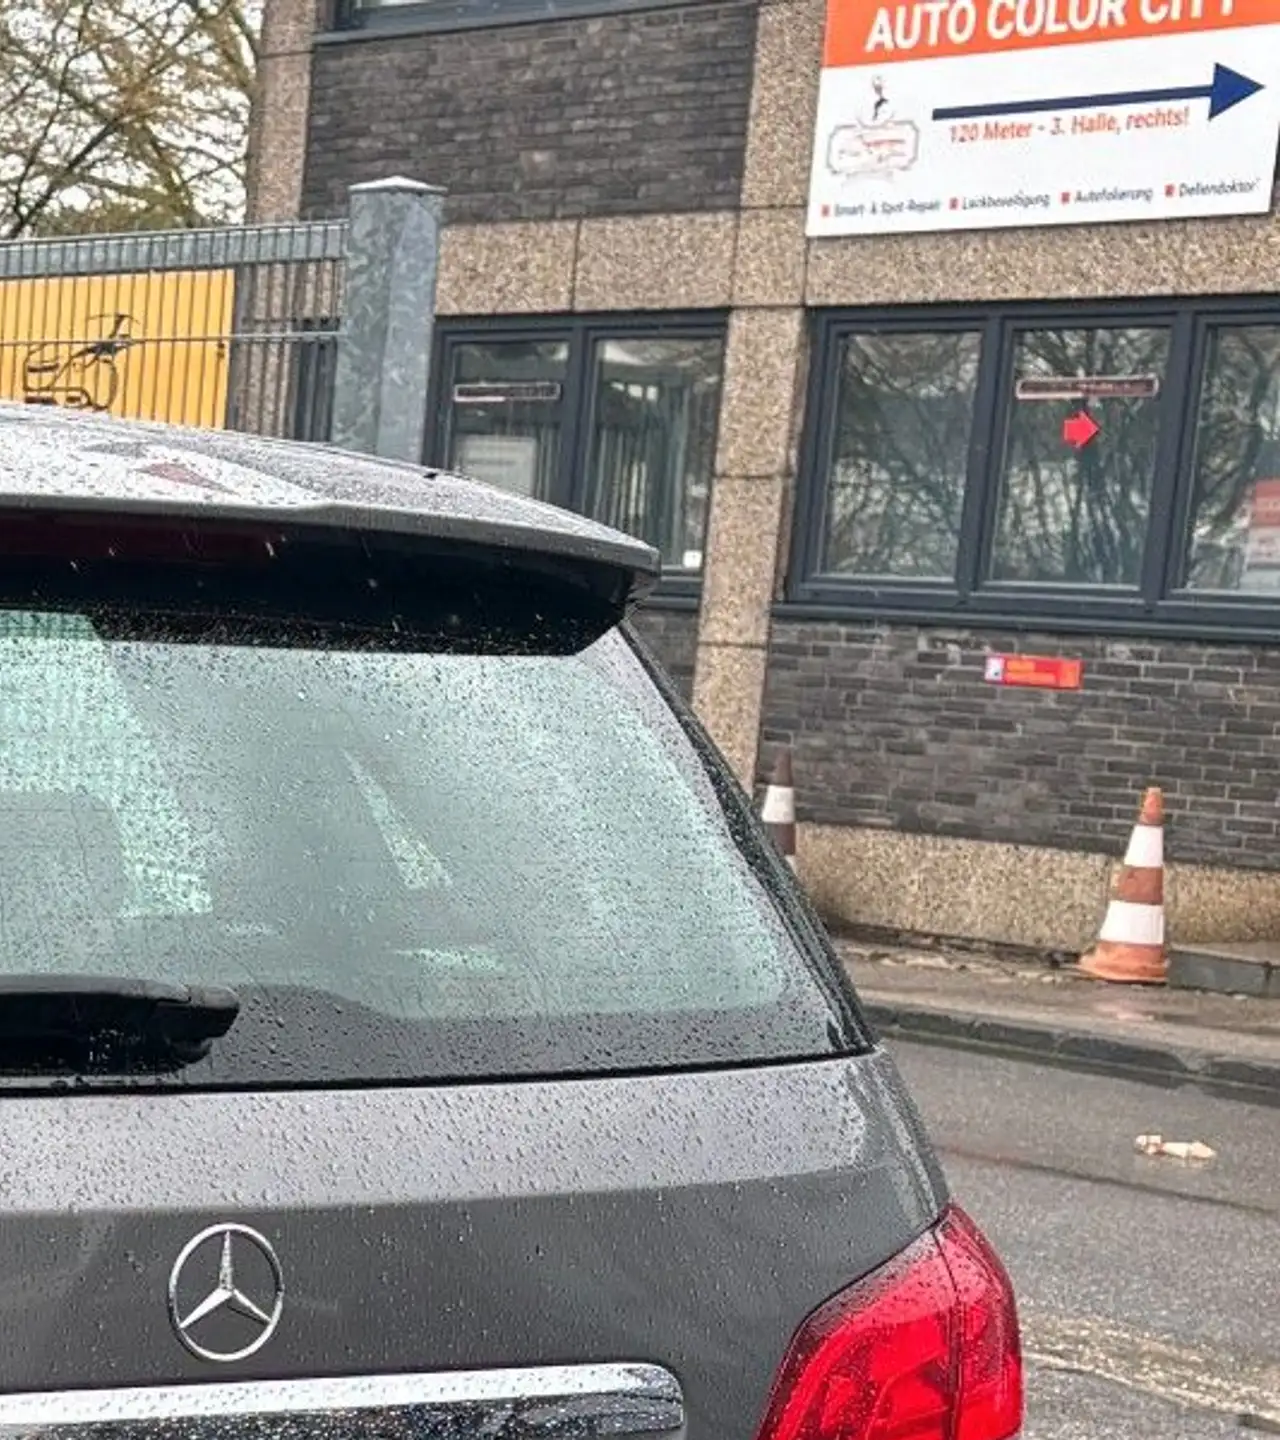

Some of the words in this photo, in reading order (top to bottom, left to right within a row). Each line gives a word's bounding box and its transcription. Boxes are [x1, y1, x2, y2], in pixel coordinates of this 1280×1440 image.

[865, 1, 977, 52] AUTO
[986, 0, 1127, 40] COLOR
[949, 123, 979, 143] 120
[982, 121, 1033, 141] Meter
[1049, 117, 1065, 136] 3.
[1071, 113, 1122, 135] Halle,
[1126, 106, 1191, 130] rechts!
